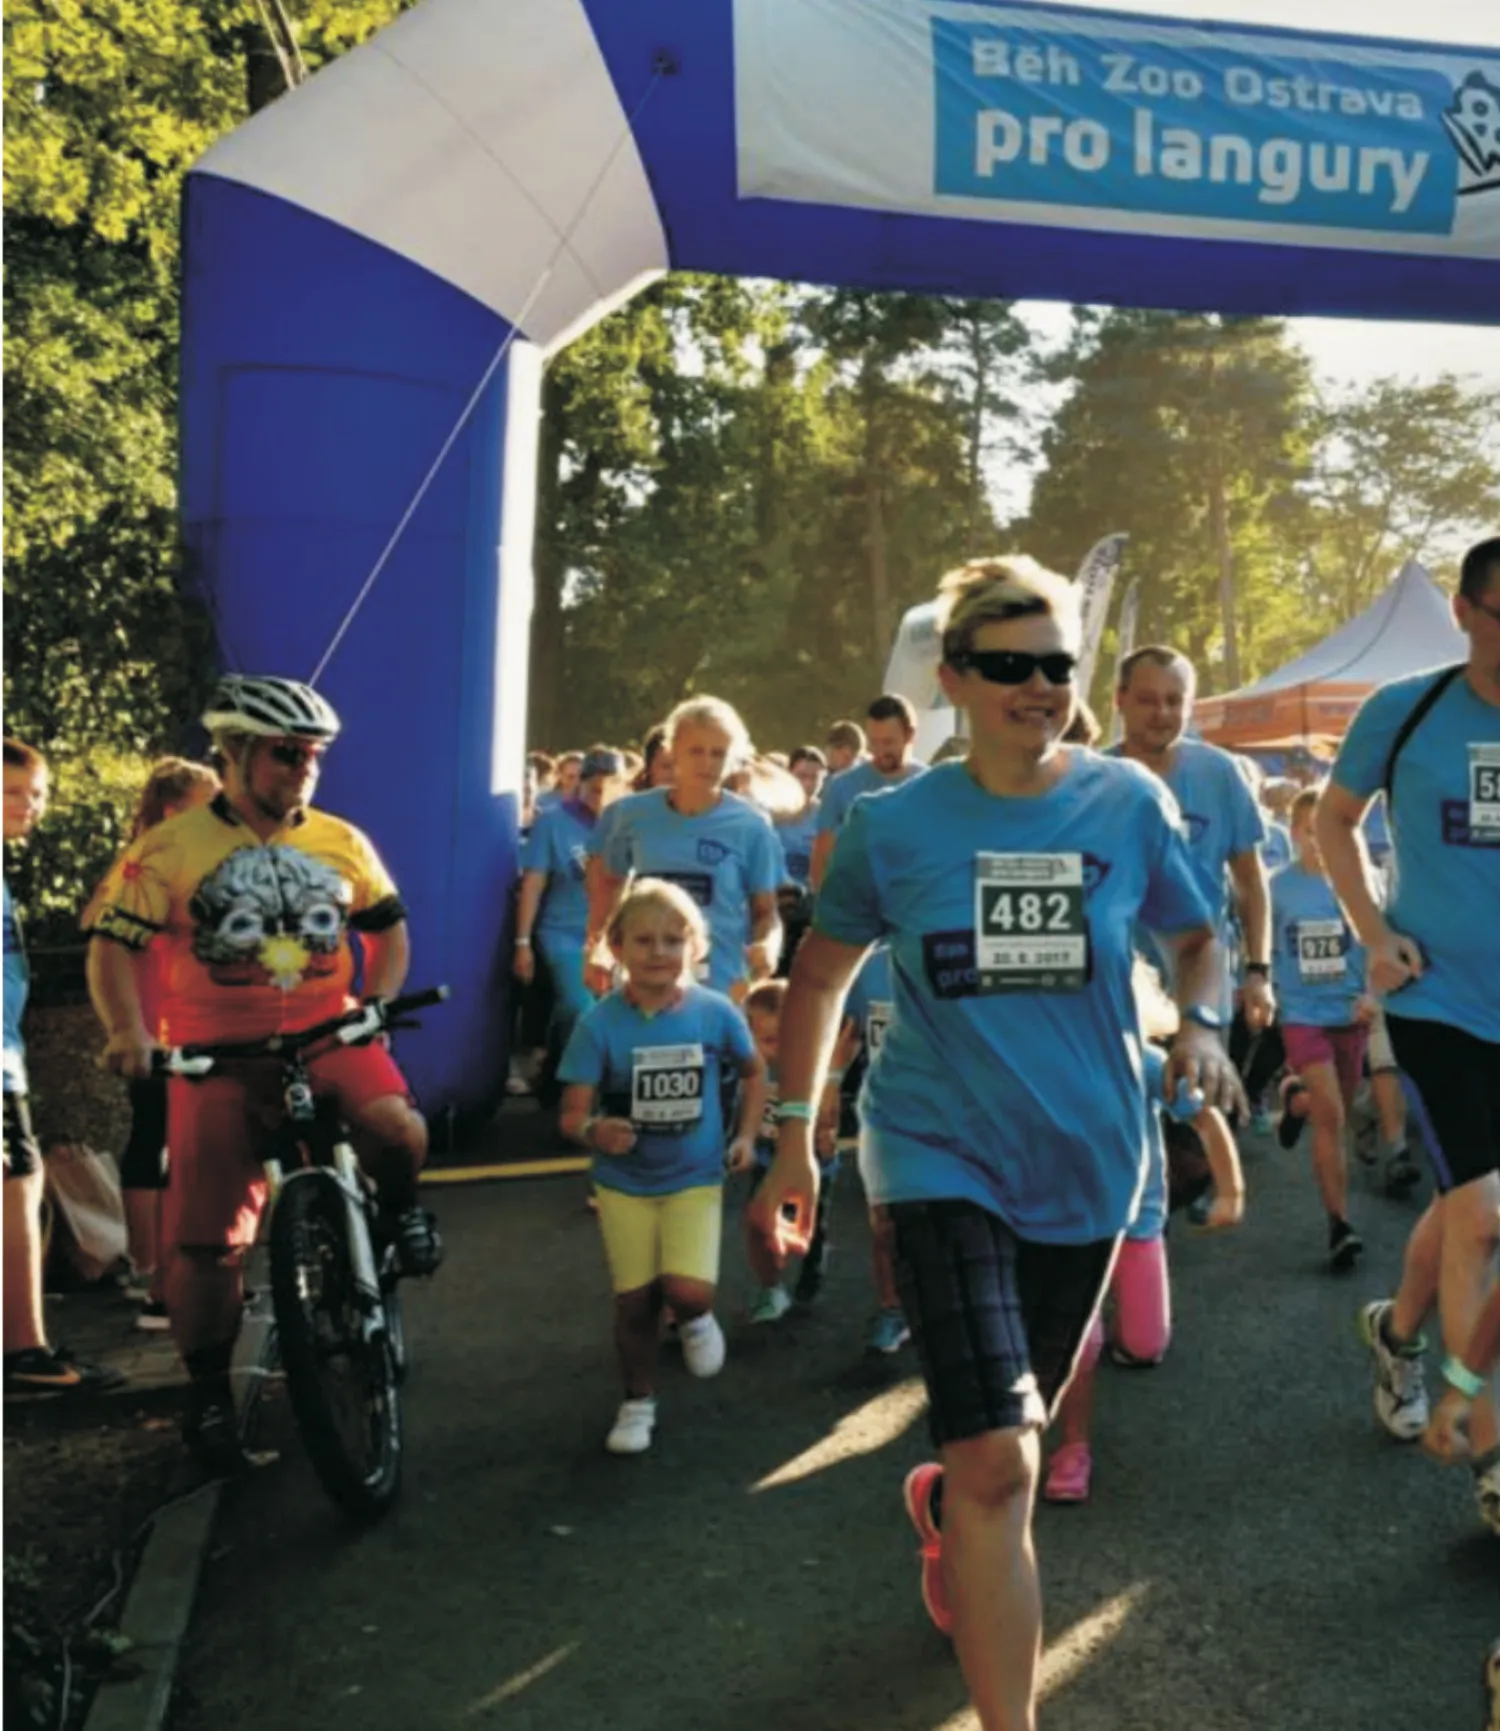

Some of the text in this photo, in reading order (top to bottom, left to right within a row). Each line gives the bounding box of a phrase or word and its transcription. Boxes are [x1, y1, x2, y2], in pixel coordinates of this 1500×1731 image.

[971, 36, 1424, 120] Běh Zoo Ostrava
[973, 107, 1430, 214] pro langury
[988, 892, 1072, 932] 482
[641, 1070, 700, 1099] 1030
